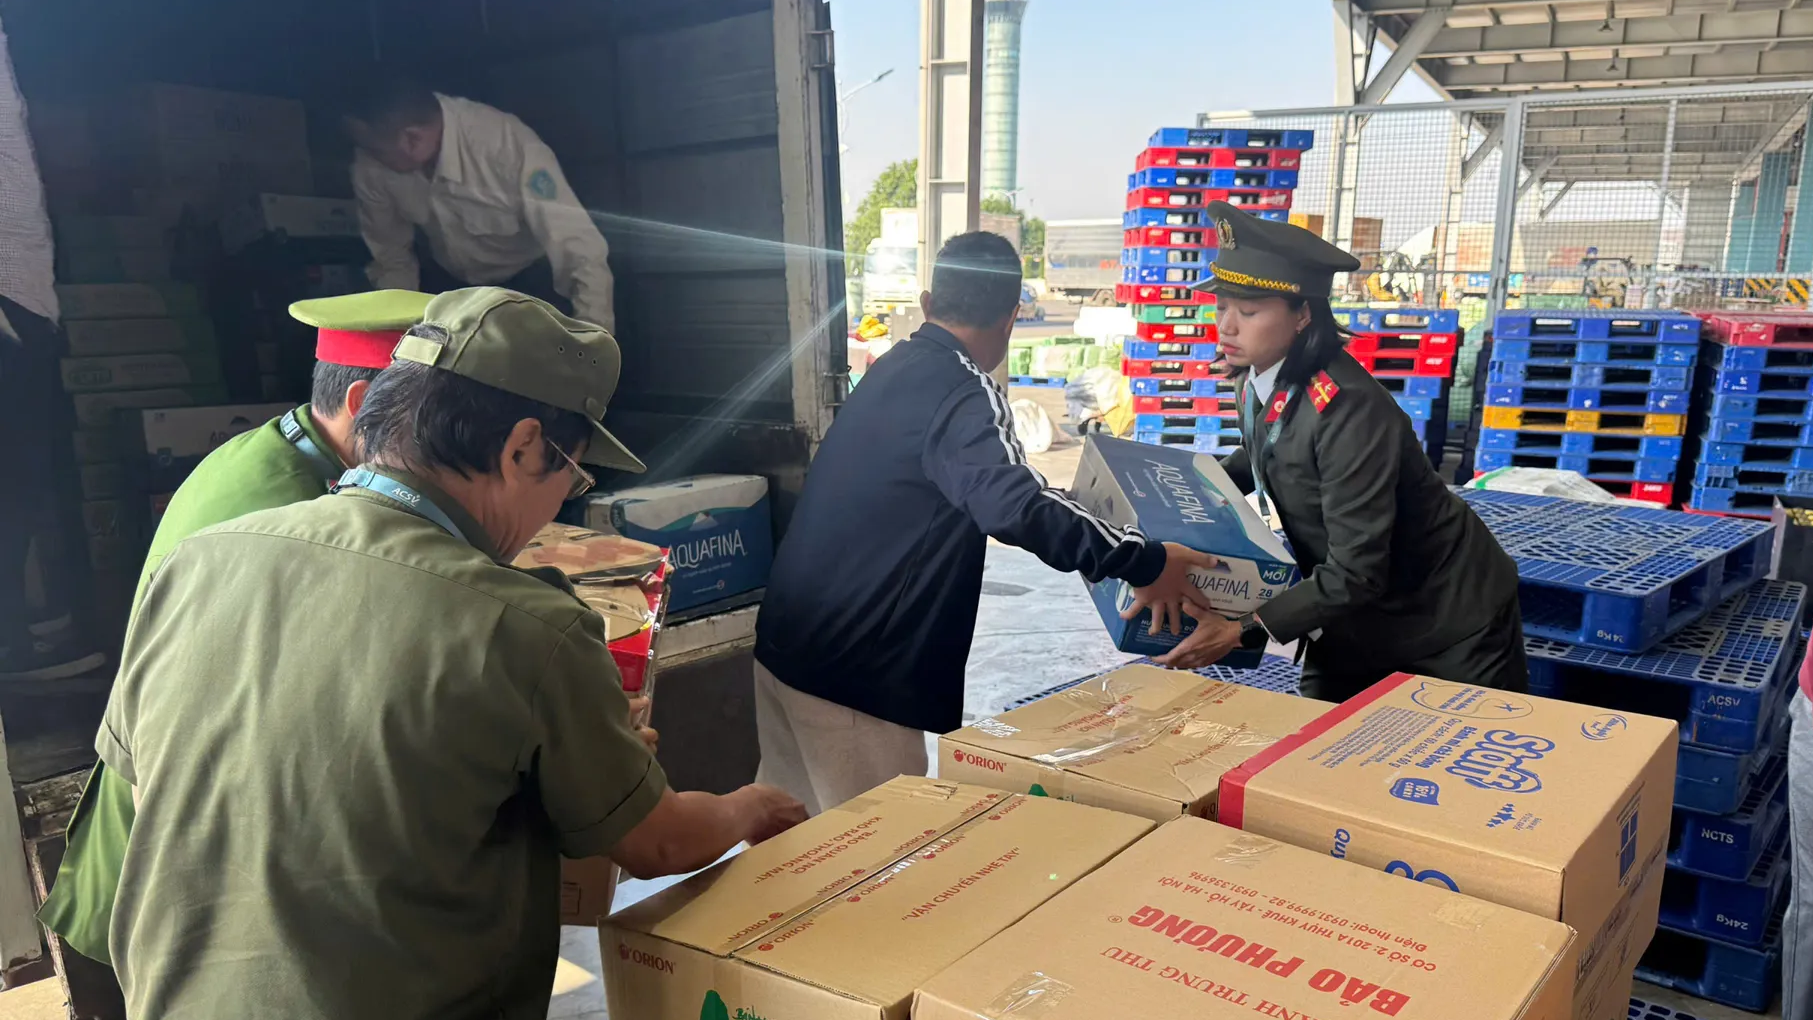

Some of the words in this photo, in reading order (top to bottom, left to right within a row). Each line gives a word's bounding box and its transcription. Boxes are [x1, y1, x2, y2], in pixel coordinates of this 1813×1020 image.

[392, 488, 420, 504] ACSV
[1145, 458, 1215, 525] AQUAFINA
[669, 529, 747, 570] AQUAFINA
[1257, 588, 1272, 598] 28
[1707, 694, 1741, 707] ACSV
[1453, 726, 1478, 742] Bánh
[966, 753, 1004, 773] ORION
[1447, 729, 1555, 793] Staff
[1701, 828, 1734, 844] NCTS
[782, 842, 834, 868] THOÁNG
[815, 844, 848, 863] QUẢN
[817, 875, 852, 896] ORION
[933, 875, 978, 903] CHUYỂN
[976, 861, 1004, 879] NHẸ
[1158, 876, 1183, 889] NỘI
[1182, 884, 1203, 895] HÀ
[1189, 871, 1259, 898] 0931.336996
[1207, 893, 1231, 903] HỒ
[1230, 900, 1256, 912] TÂY
[1261, 909, 1299, 926] KHUÊ
[1269, 896, 1349, 927] 0931.9999.82
[727, 919, 769, 943] ORION
[774, 919, 815, 943] ORION
[1298, 922, 1334, 938] THỤY
[1716, 913, 1748, 930] 24Kg
[1350, 922, 1391, 941] thoại:
[1128, 905, 1305, 978] PHƯƠNG
[1337, 933, 1372, 950] 201A
[1373, 945, 1389, 955] 2:
[1394, 936, 1428, 952] Điện
[632, 949, 674, 974] ORION
[1100, 947, 1156, 971] THU
[1387, 951, 1411, 962] SỞ
[1411, 959, 1437, 971] CƠ
[1158, 966, 1250, 1006] TRUNG
[1308, 968, 1411, 1017] BẢO
